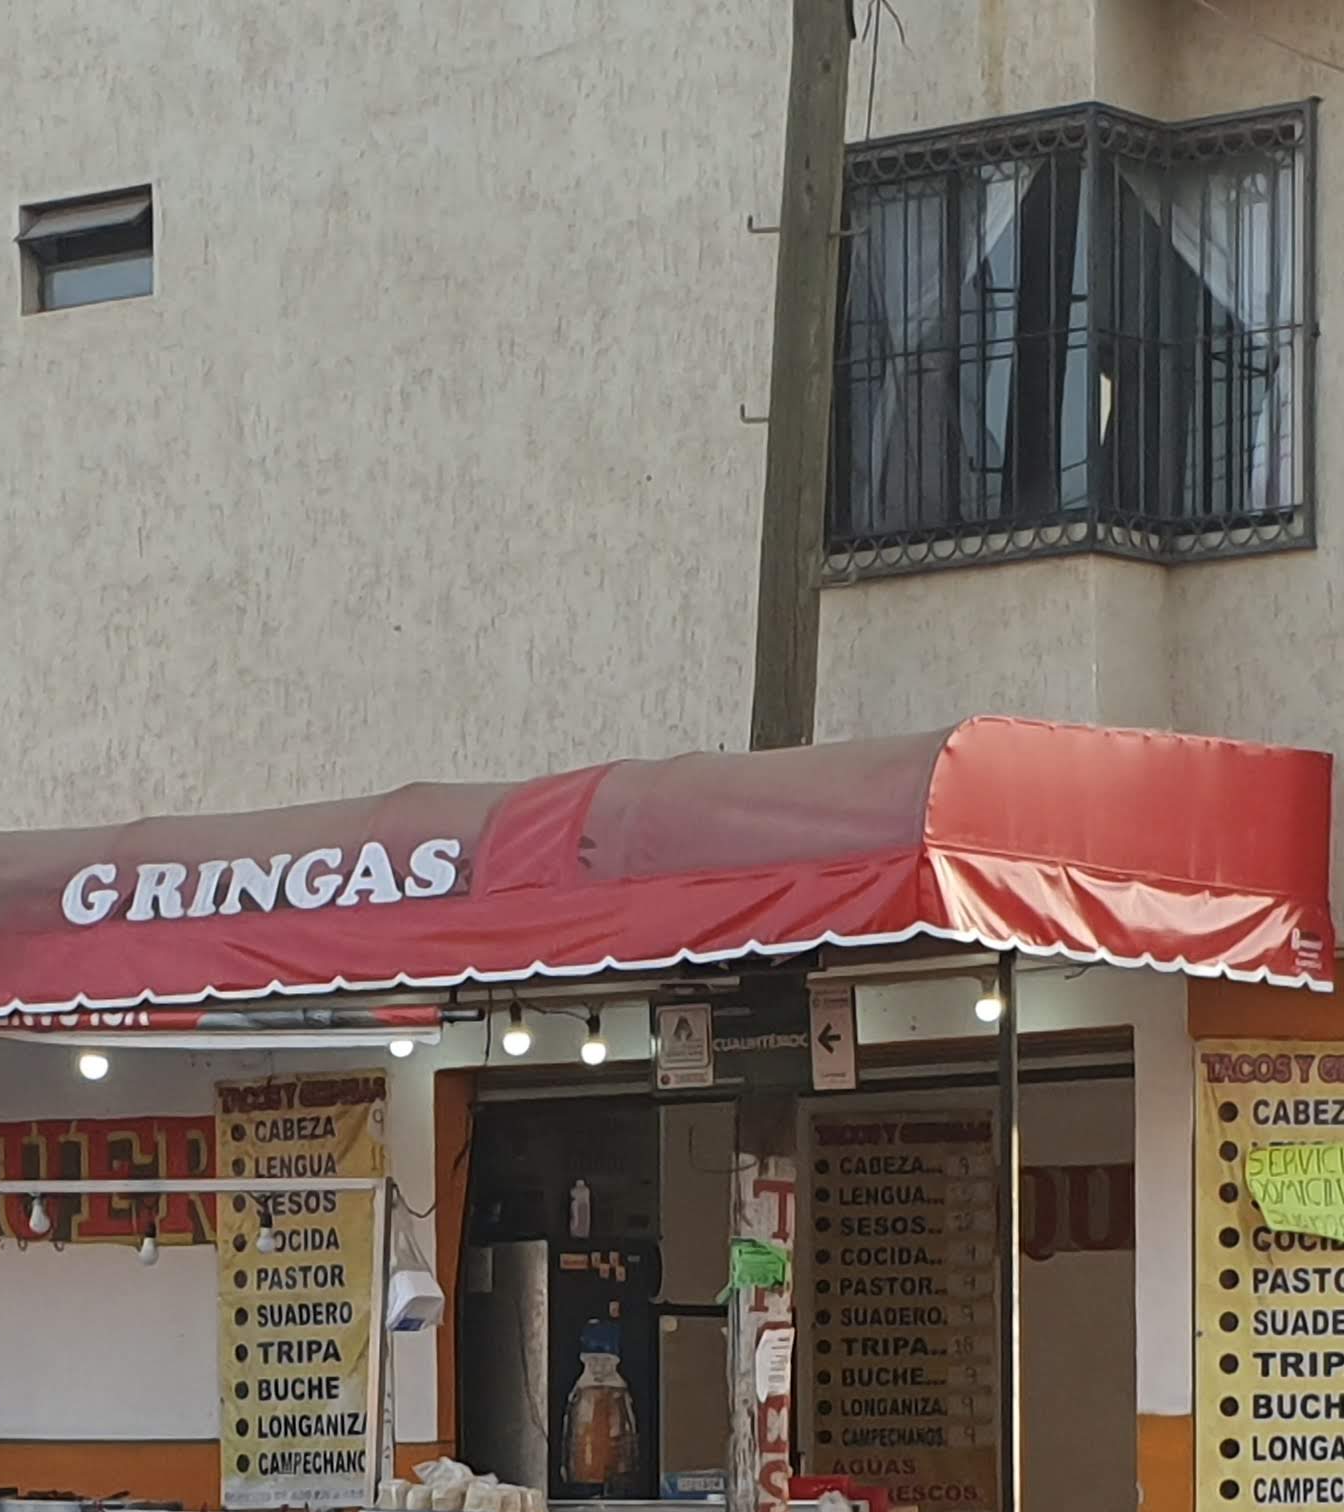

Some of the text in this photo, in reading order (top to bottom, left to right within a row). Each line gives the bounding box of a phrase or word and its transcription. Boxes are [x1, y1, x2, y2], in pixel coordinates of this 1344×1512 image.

[60, 838, 461, 926] GRINGAS
[1201, 1054, 1291, 1083] TACOS
[1292, 1054, 1316, 1083] Y
[254, 1115, 336, 1143] CABEZA
[254, 1153, 337, 1178] LENGUA
[256, 1264, 345, 1291] PASTOR
[256, 1301, 353, 1328] SUADERO
[257, 1339, 342, 1364] TRIPA
[257, 1376, 340, 1402] BUCHE
